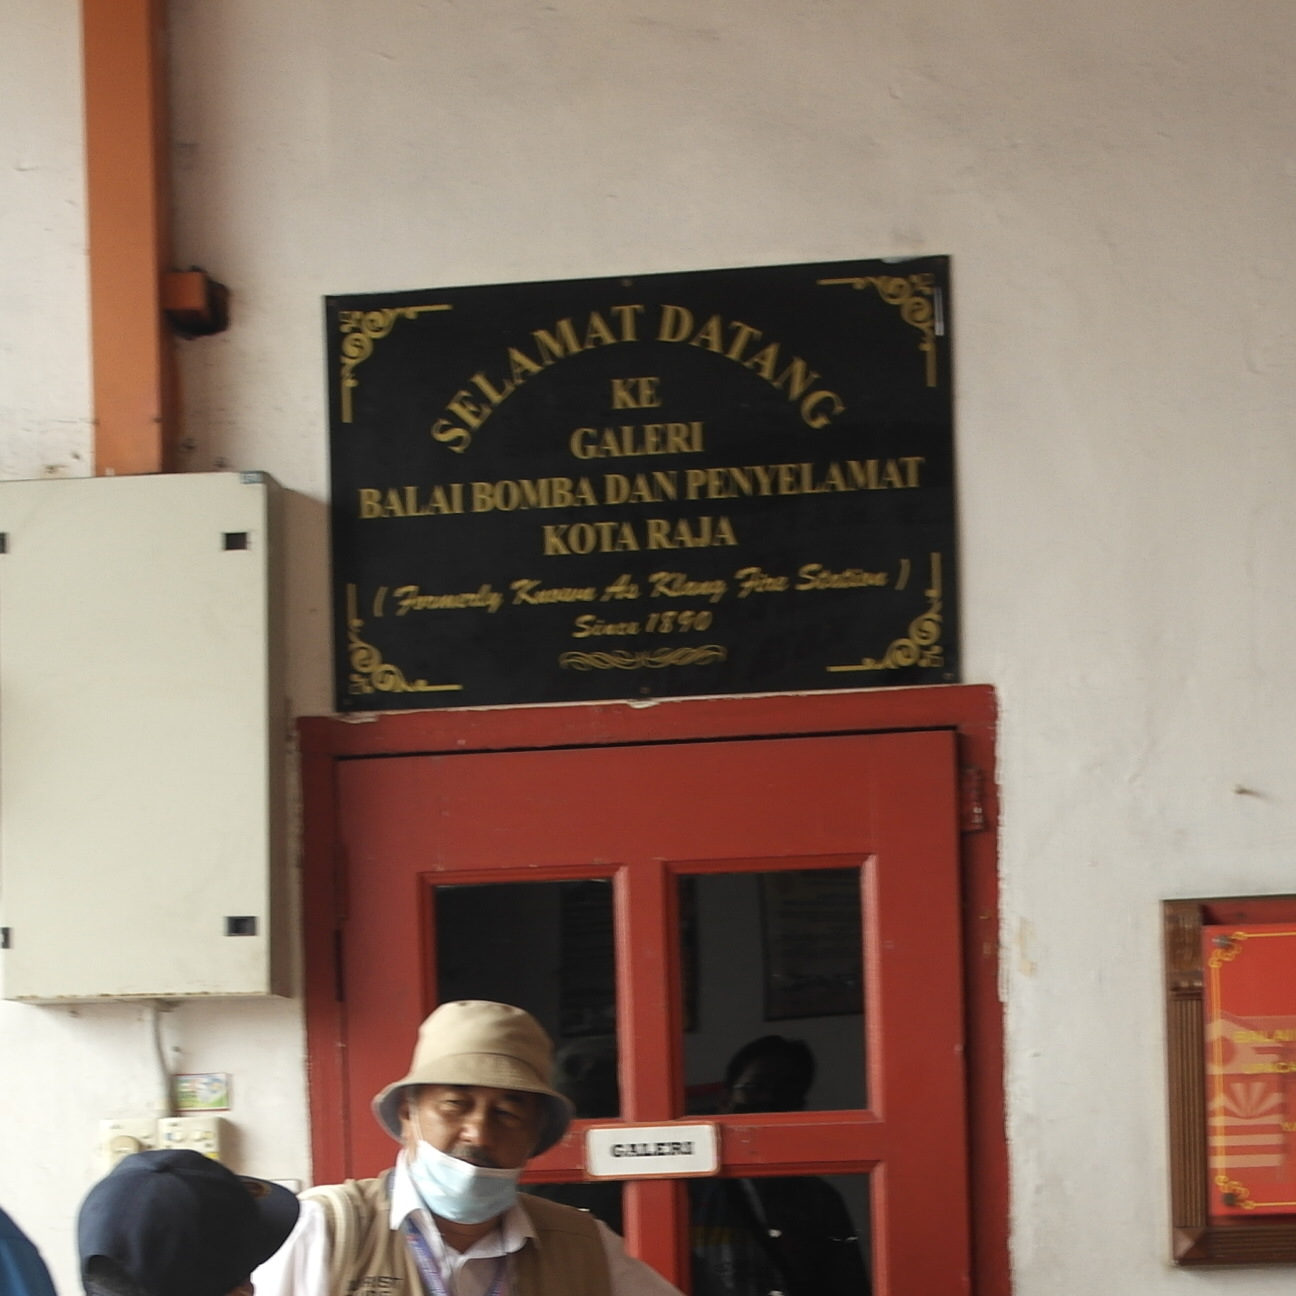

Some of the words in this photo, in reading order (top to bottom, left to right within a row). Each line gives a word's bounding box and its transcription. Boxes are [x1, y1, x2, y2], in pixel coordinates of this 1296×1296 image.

[431, 305, 644, 454] SELAMAT
[657, 304, 846, 430] DATANG
[612, 376, 661, 410] KE
[570, 421, 704, 460] GALERI
[359, 486, 463, 519] BALAI
[472, 475, 597, 513] BOMBA
[604, 470, 677, 505] DAN
[688, 456, 925, 501] PENYELAMAT
[542, 519, 639, 556] KOTA
[647, 515, 738, 551] RAJA
[389, 584, 502, 616] Formerly
[653, 568, 728, 603] Klang
[733, 565, 789, 597] Fire
[795, 561, 889, 593] Station
[573, 612, 641, 640] Since
[646, 609, 713, 636] 1890
[1232, 1029, 1294, 1042] BALAI
[610, 1141, 694, 1158] GALERI
